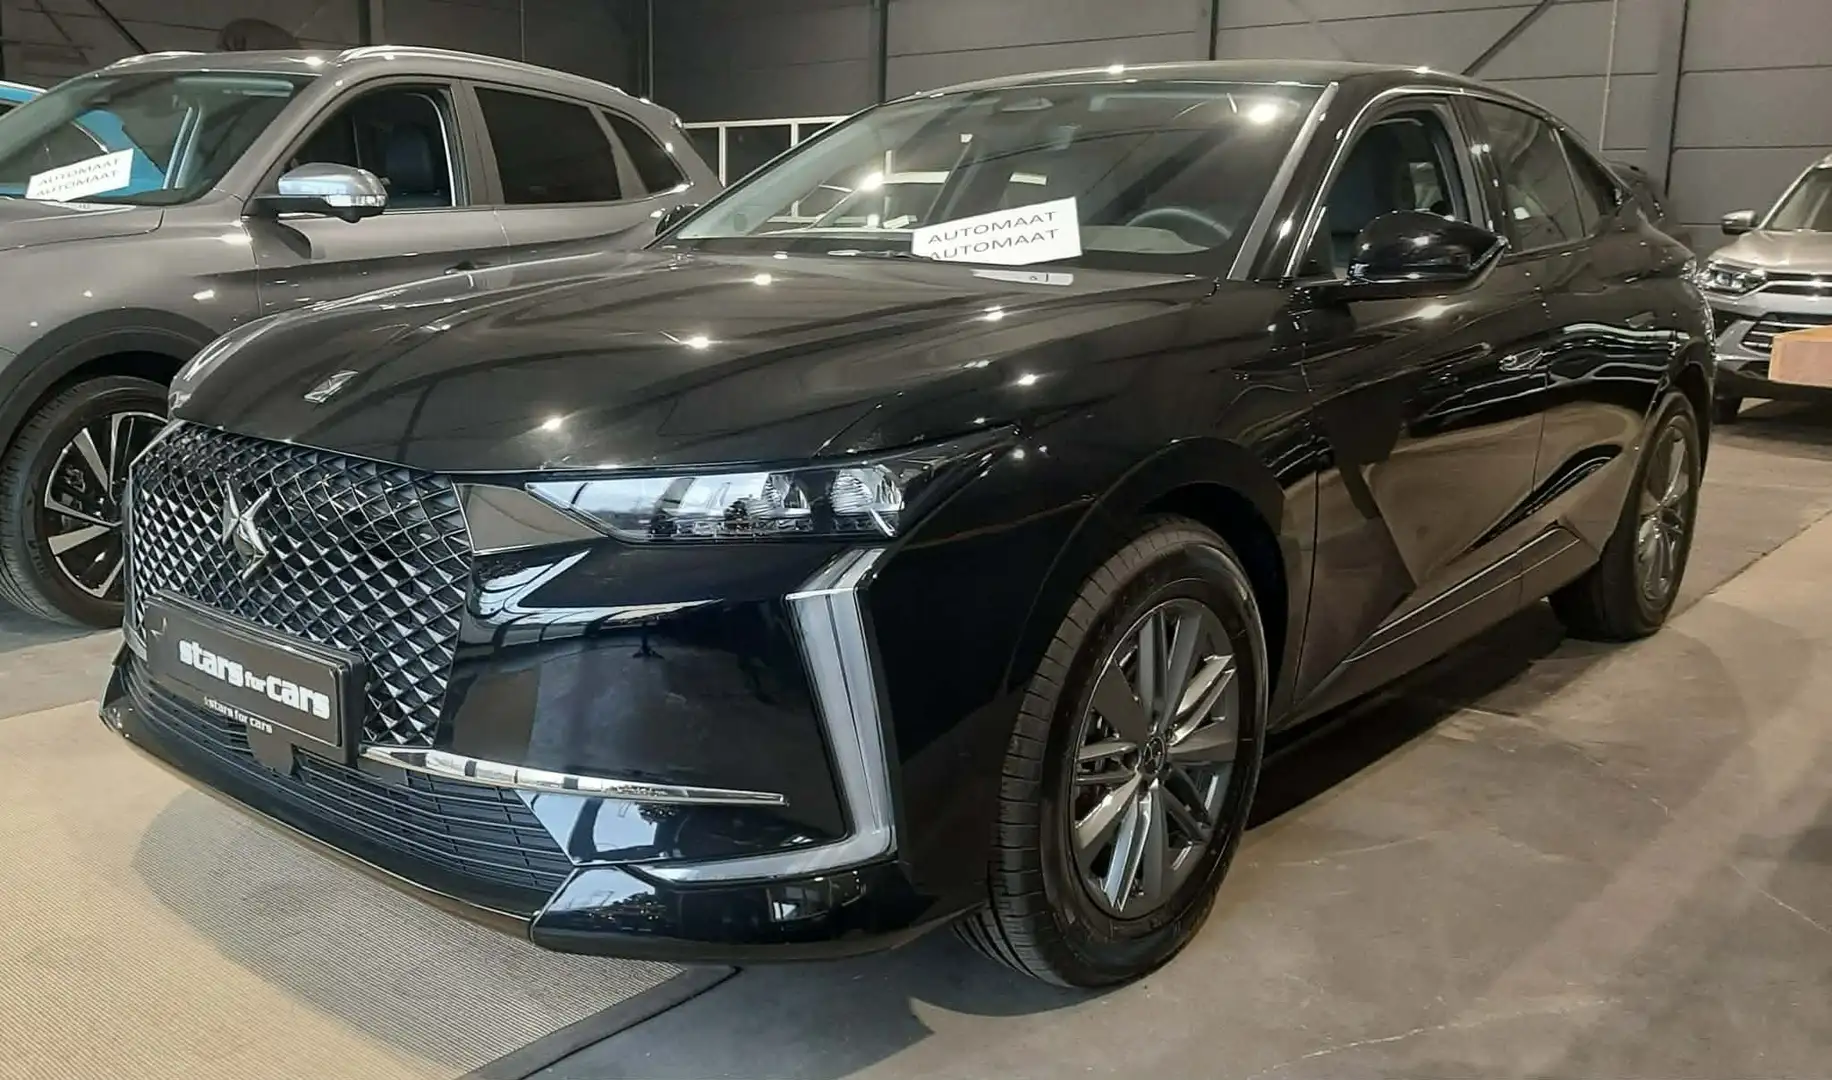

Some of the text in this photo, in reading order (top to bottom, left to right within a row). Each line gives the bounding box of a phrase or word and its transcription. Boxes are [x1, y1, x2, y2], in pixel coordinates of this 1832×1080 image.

[928, 211, 1058, 244] AUTOMAAT
[929, 229, 1060, 260] AUTOMAAT
[178, 640, 330, 719] stars for cars
[234, 709, 248, 723] for
[249, 717, 273, 734] cars
